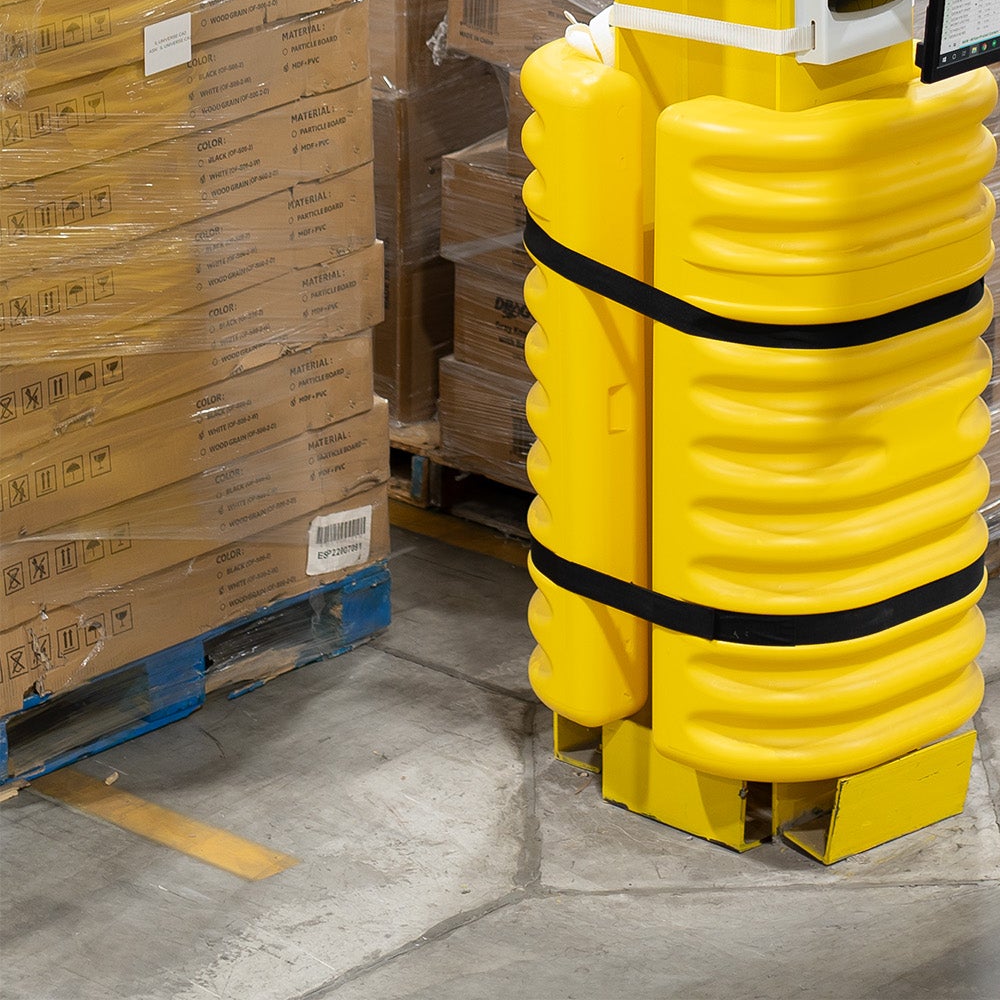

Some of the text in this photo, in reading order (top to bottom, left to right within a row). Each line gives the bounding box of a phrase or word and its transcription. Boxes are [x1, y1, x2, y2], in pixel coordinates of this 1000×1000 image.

[197, 137, 227, 152] COLOR:
[196, 393, 225, 409] COLOR:
[215, 548, 245, 564] COLOR:
